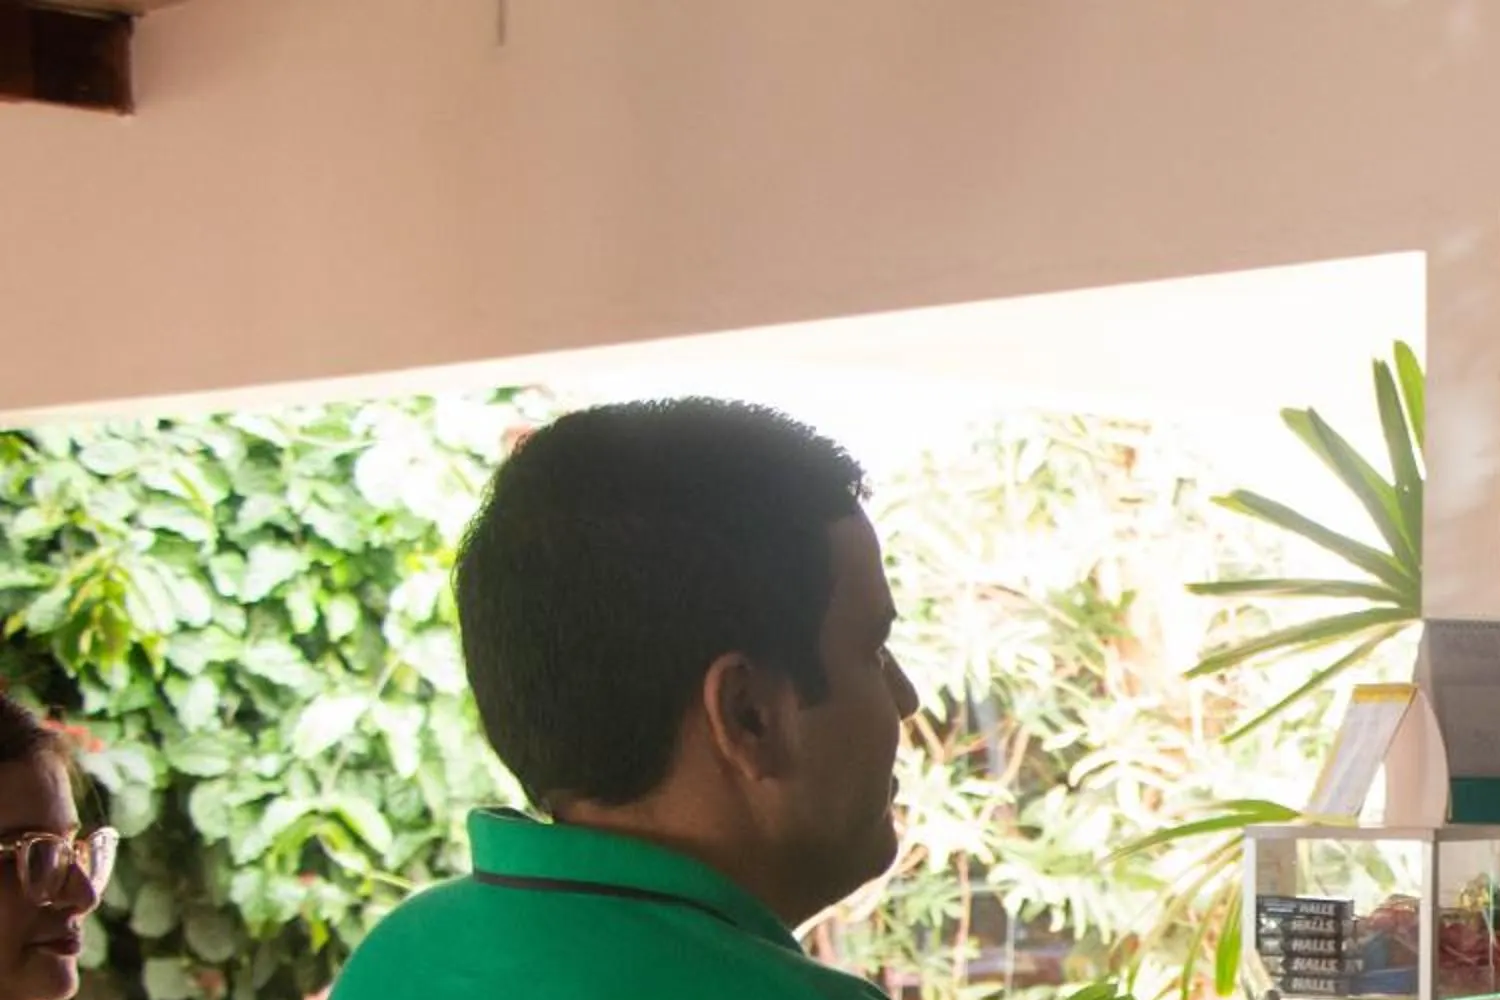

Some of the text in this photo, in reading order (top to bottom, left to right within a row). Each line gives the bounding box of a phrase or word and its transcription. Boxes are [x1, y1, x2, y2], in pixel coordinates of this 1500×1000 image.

[1292, 938, 1336, 952] HALLS
[1292, 957, 1338, 971] HALLS
[1292, 977, 1336, 991] HALLS
